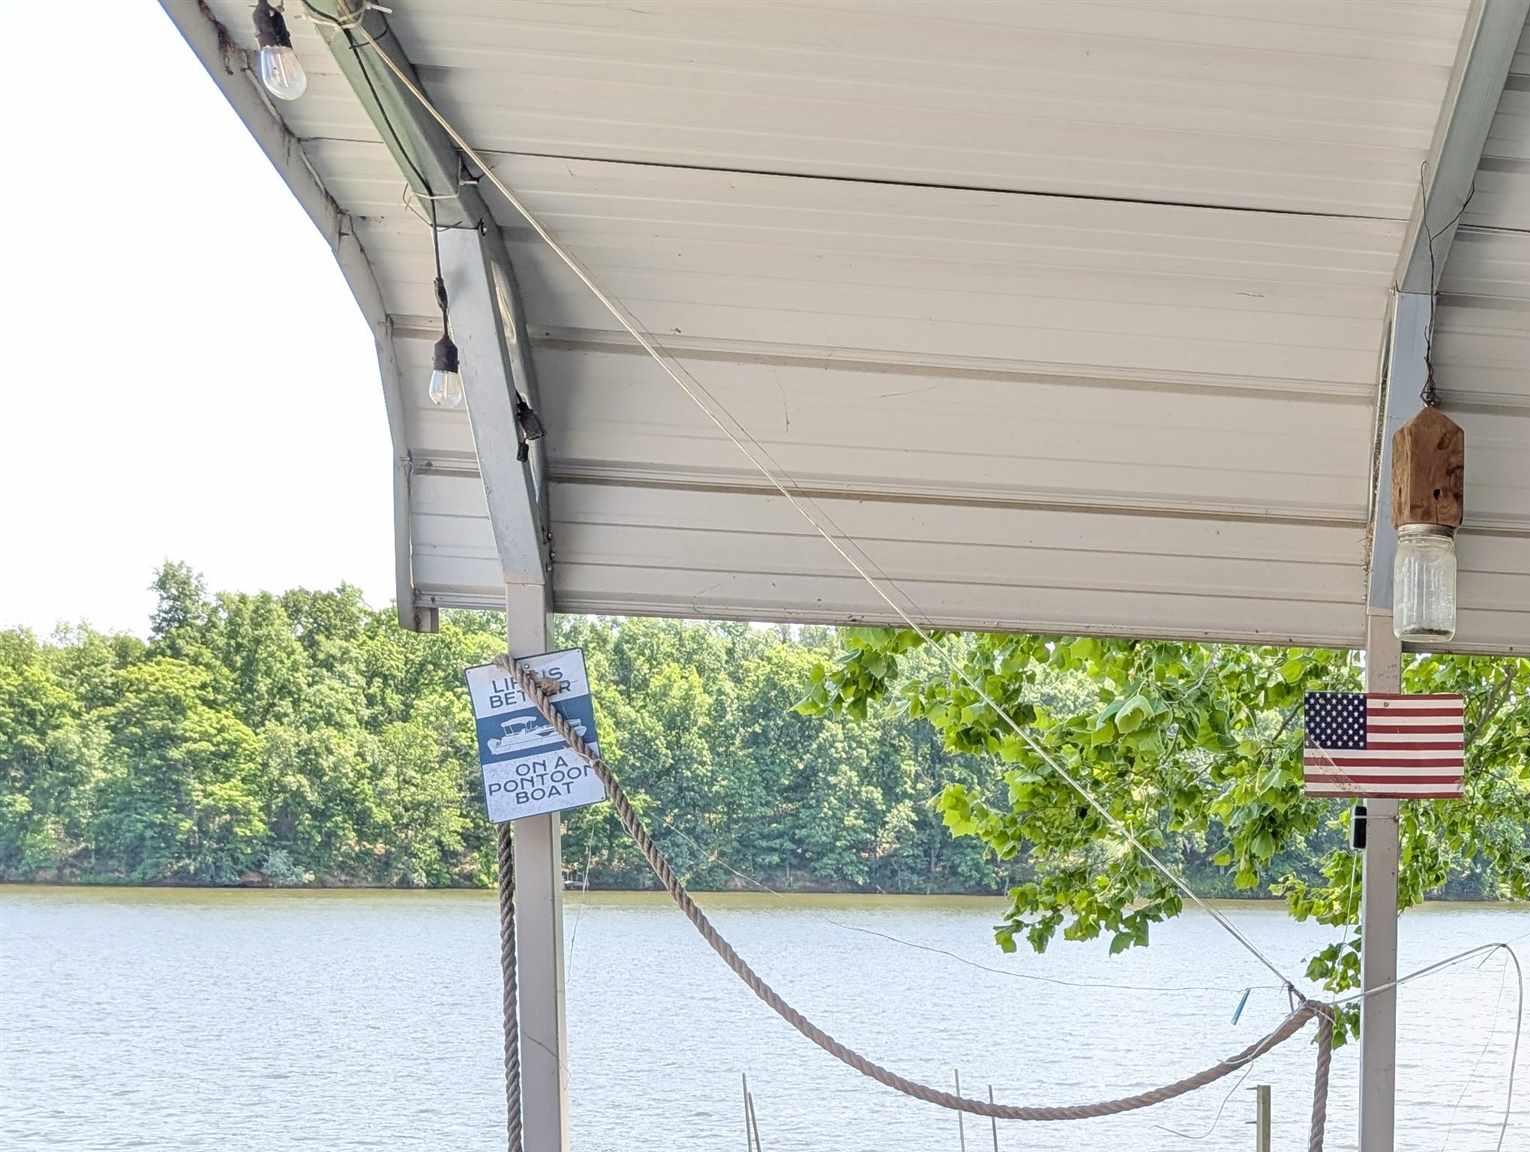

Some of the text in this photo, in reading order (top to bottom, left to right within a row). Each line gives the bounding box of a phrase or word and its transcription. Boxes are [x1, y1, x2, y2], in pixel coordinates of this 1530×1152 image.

[489, 680, 571, 709] BETR
[492, 676, 523, 694] LIF
[515, 755, 568, 776] ON A
[515, 781, 575, 805] BOAT
